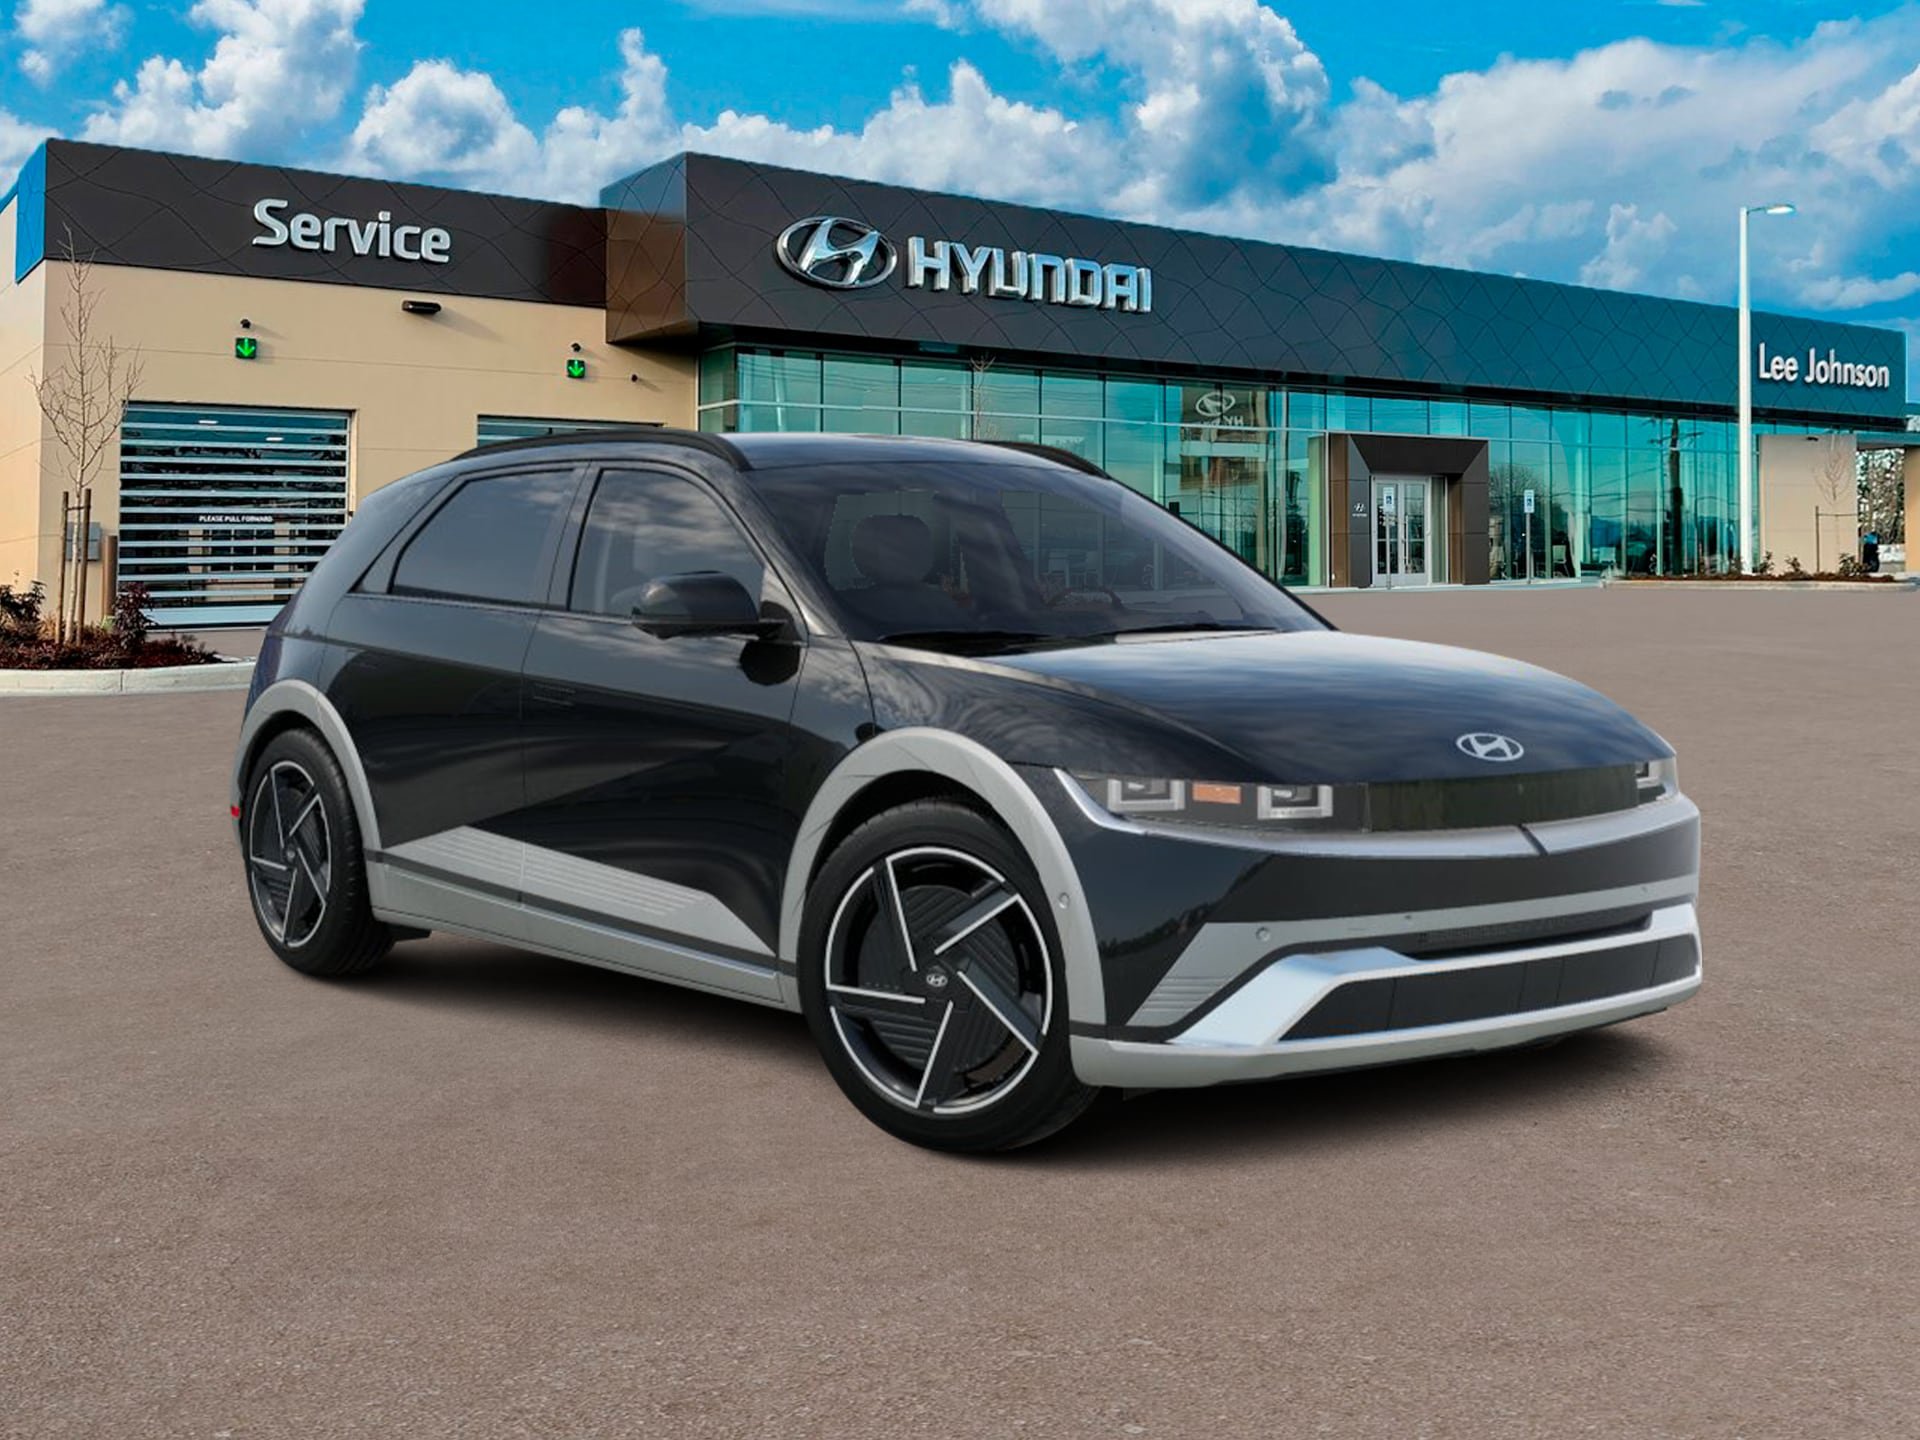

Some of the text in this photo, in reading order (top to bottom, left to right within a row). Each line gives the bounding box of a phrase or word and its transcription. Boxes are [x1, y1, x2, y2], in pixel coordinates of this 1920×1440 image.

[252, 198, 451, 263] Service
[907, 235, 1152, 313] HYUNDAI
[1759, 342, 1890, 388] Lee Johnson
